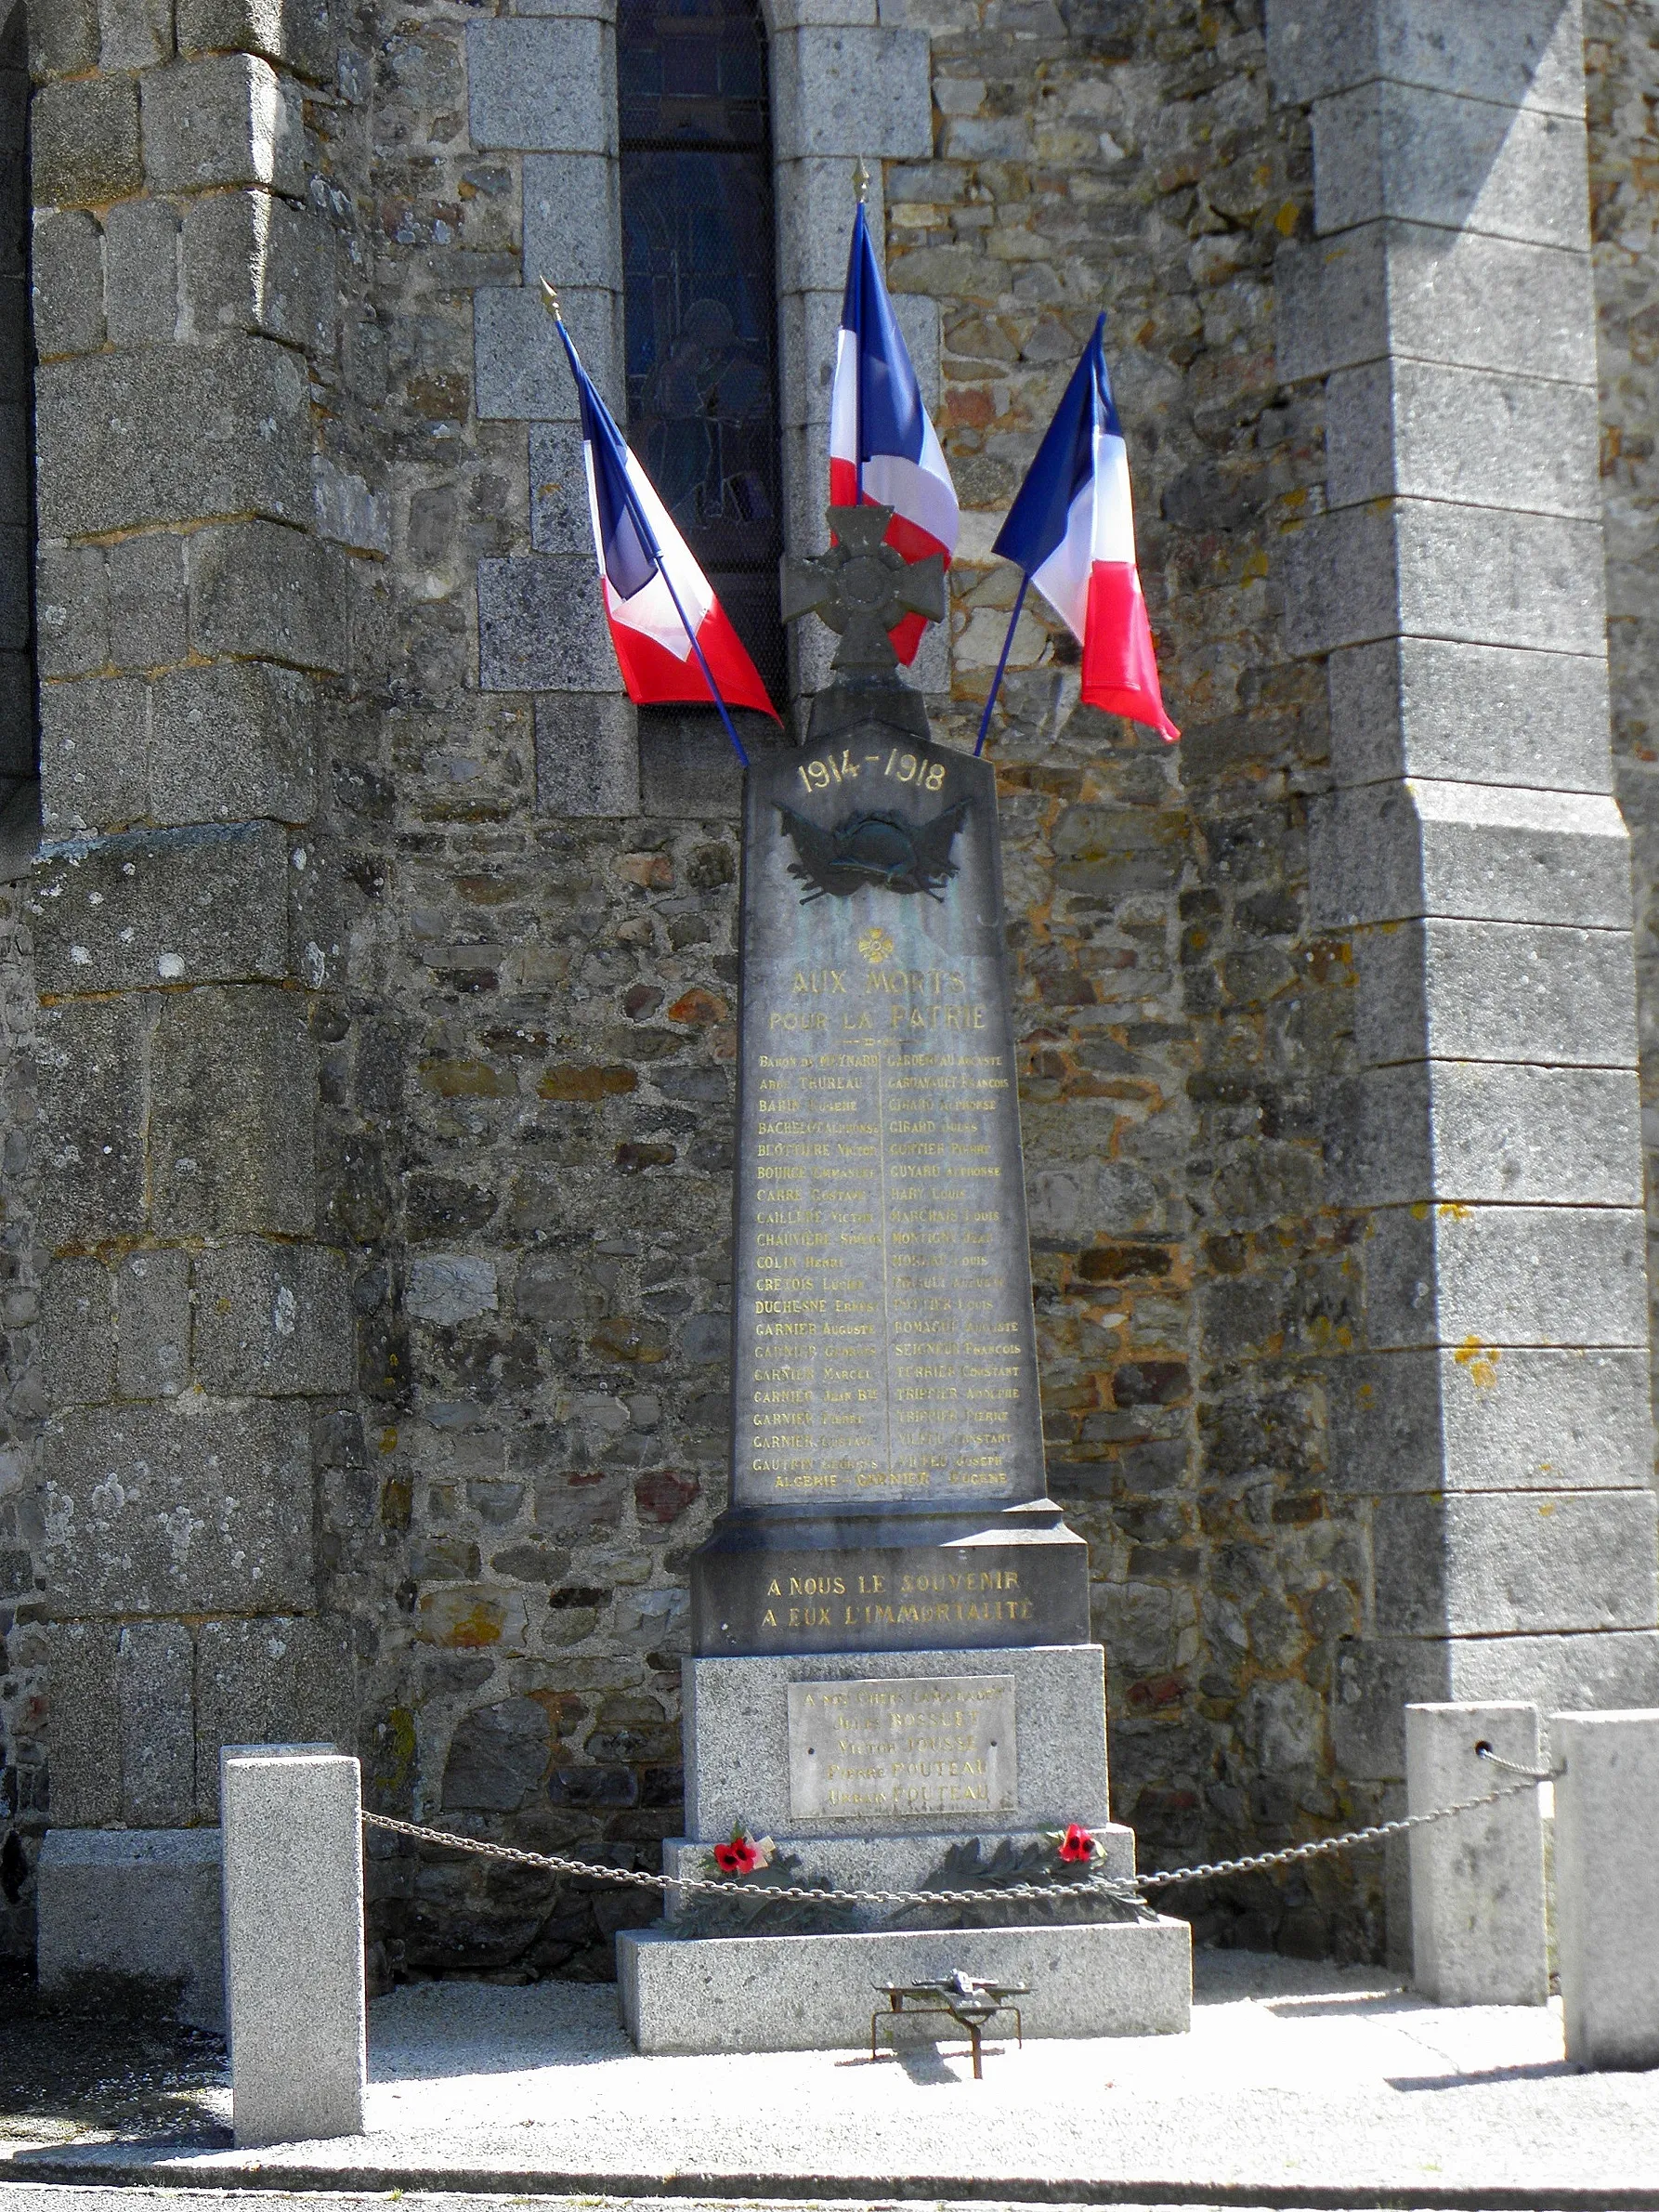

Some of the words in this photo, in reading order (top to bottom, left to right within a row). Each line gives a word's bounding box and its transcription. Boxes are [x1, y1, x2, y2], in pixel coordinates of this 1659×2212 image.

[798, 749, 946, 792] 1914-1918
[793, 970, 846, 994] AUX
[865, 969, 966, 996] MORTS
[769, 1013, 829, 1031] POUR
[843, 1011, 873, 1030] LA
[891, 1003, 986, 1030] PATRIE
[800, 1077, 863, 1090] THUREAU
[756, 1256, 796, 1269] COLIN
[754, 1300, 827, 1314] DUCHESNE
[755, 1323, 816, 1335] GARNIER
[821, 1323, 876, 1334] AUGUSTE
[754, 1368, 815, 1381] GARNIER
[753, 1391, 813, 1403] GARNIER
[752, 1413, 812, 1426] GARNIER
[752, 1435, 814, 1448] GARNIER
[767, 1578, 782, 1596] A
[790, 1577, 846, 1596] NOUS
[858, 1575, 885, 1594] LE
[900, 1571, 1019, 1593] SOUVENIR
[762, 1609, 777, 1628] A
[789, 1607, 831, 1627] EUX
[804, 1693, 816, 1708] A
[892, 1760, 986, 1778] POUTEAU
[892, 1784, 989, 1803] POUTEAU
